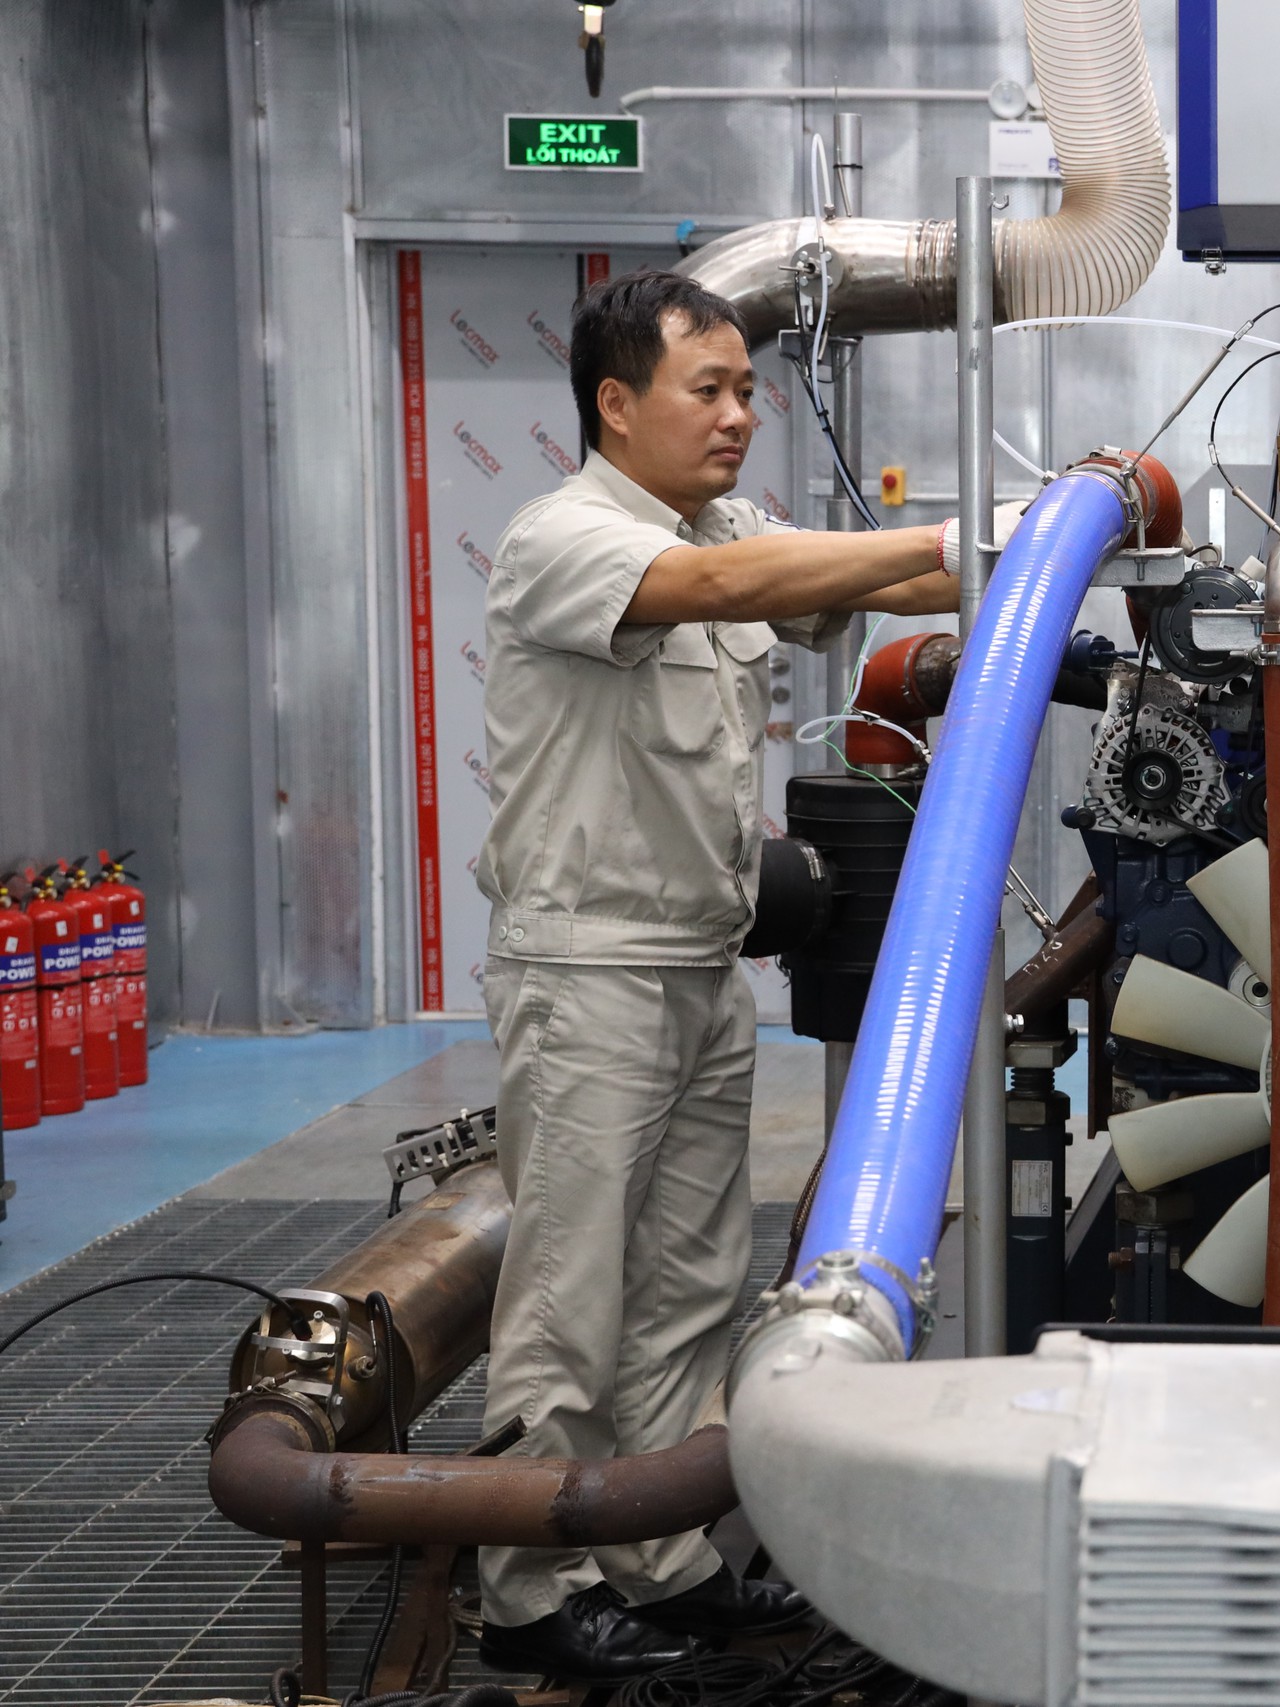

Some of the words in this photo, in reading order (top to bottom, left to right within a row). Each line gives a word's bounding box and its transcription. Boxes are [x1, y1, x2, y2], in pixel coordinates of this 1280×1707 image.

[540, 123, 606, 144] EXIT
[559, 145, 620, 163] THOÁT
[527, 309, 571, 364] Lecma
